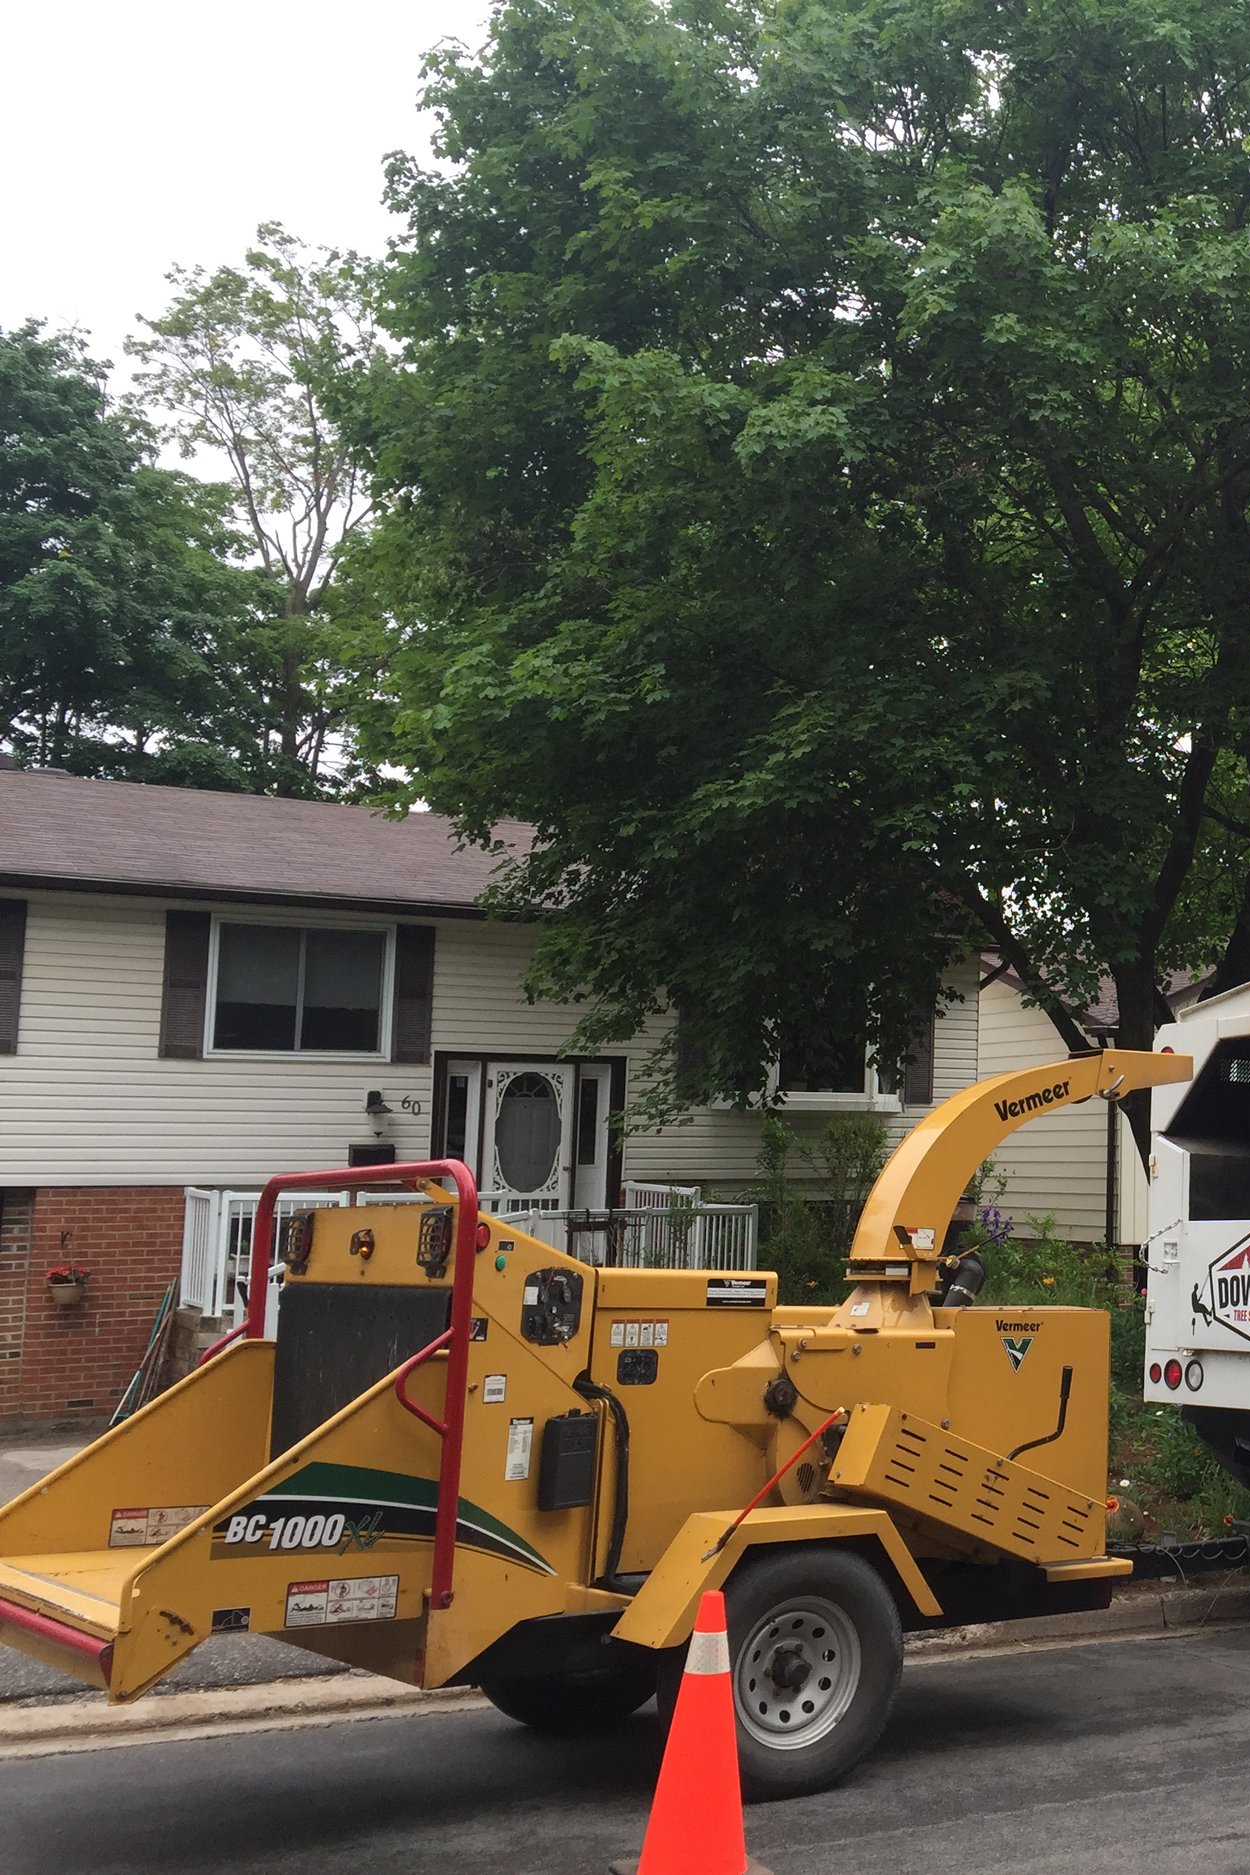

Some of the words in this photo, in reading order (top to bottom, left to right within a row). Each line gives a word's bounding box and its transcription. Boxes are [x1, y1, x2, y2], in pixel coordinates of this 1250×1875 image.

[401, 1094, 421, 1116] 60
[994, 1081, 1070, 1122] Vermeer
[995, 1319, 1041, 1332] Vermeer
[1233, 1309, 1247, 1322] TREE
[224, 1514, 267, 1544] BC
[269, 1513, 345, 1550] 1000
